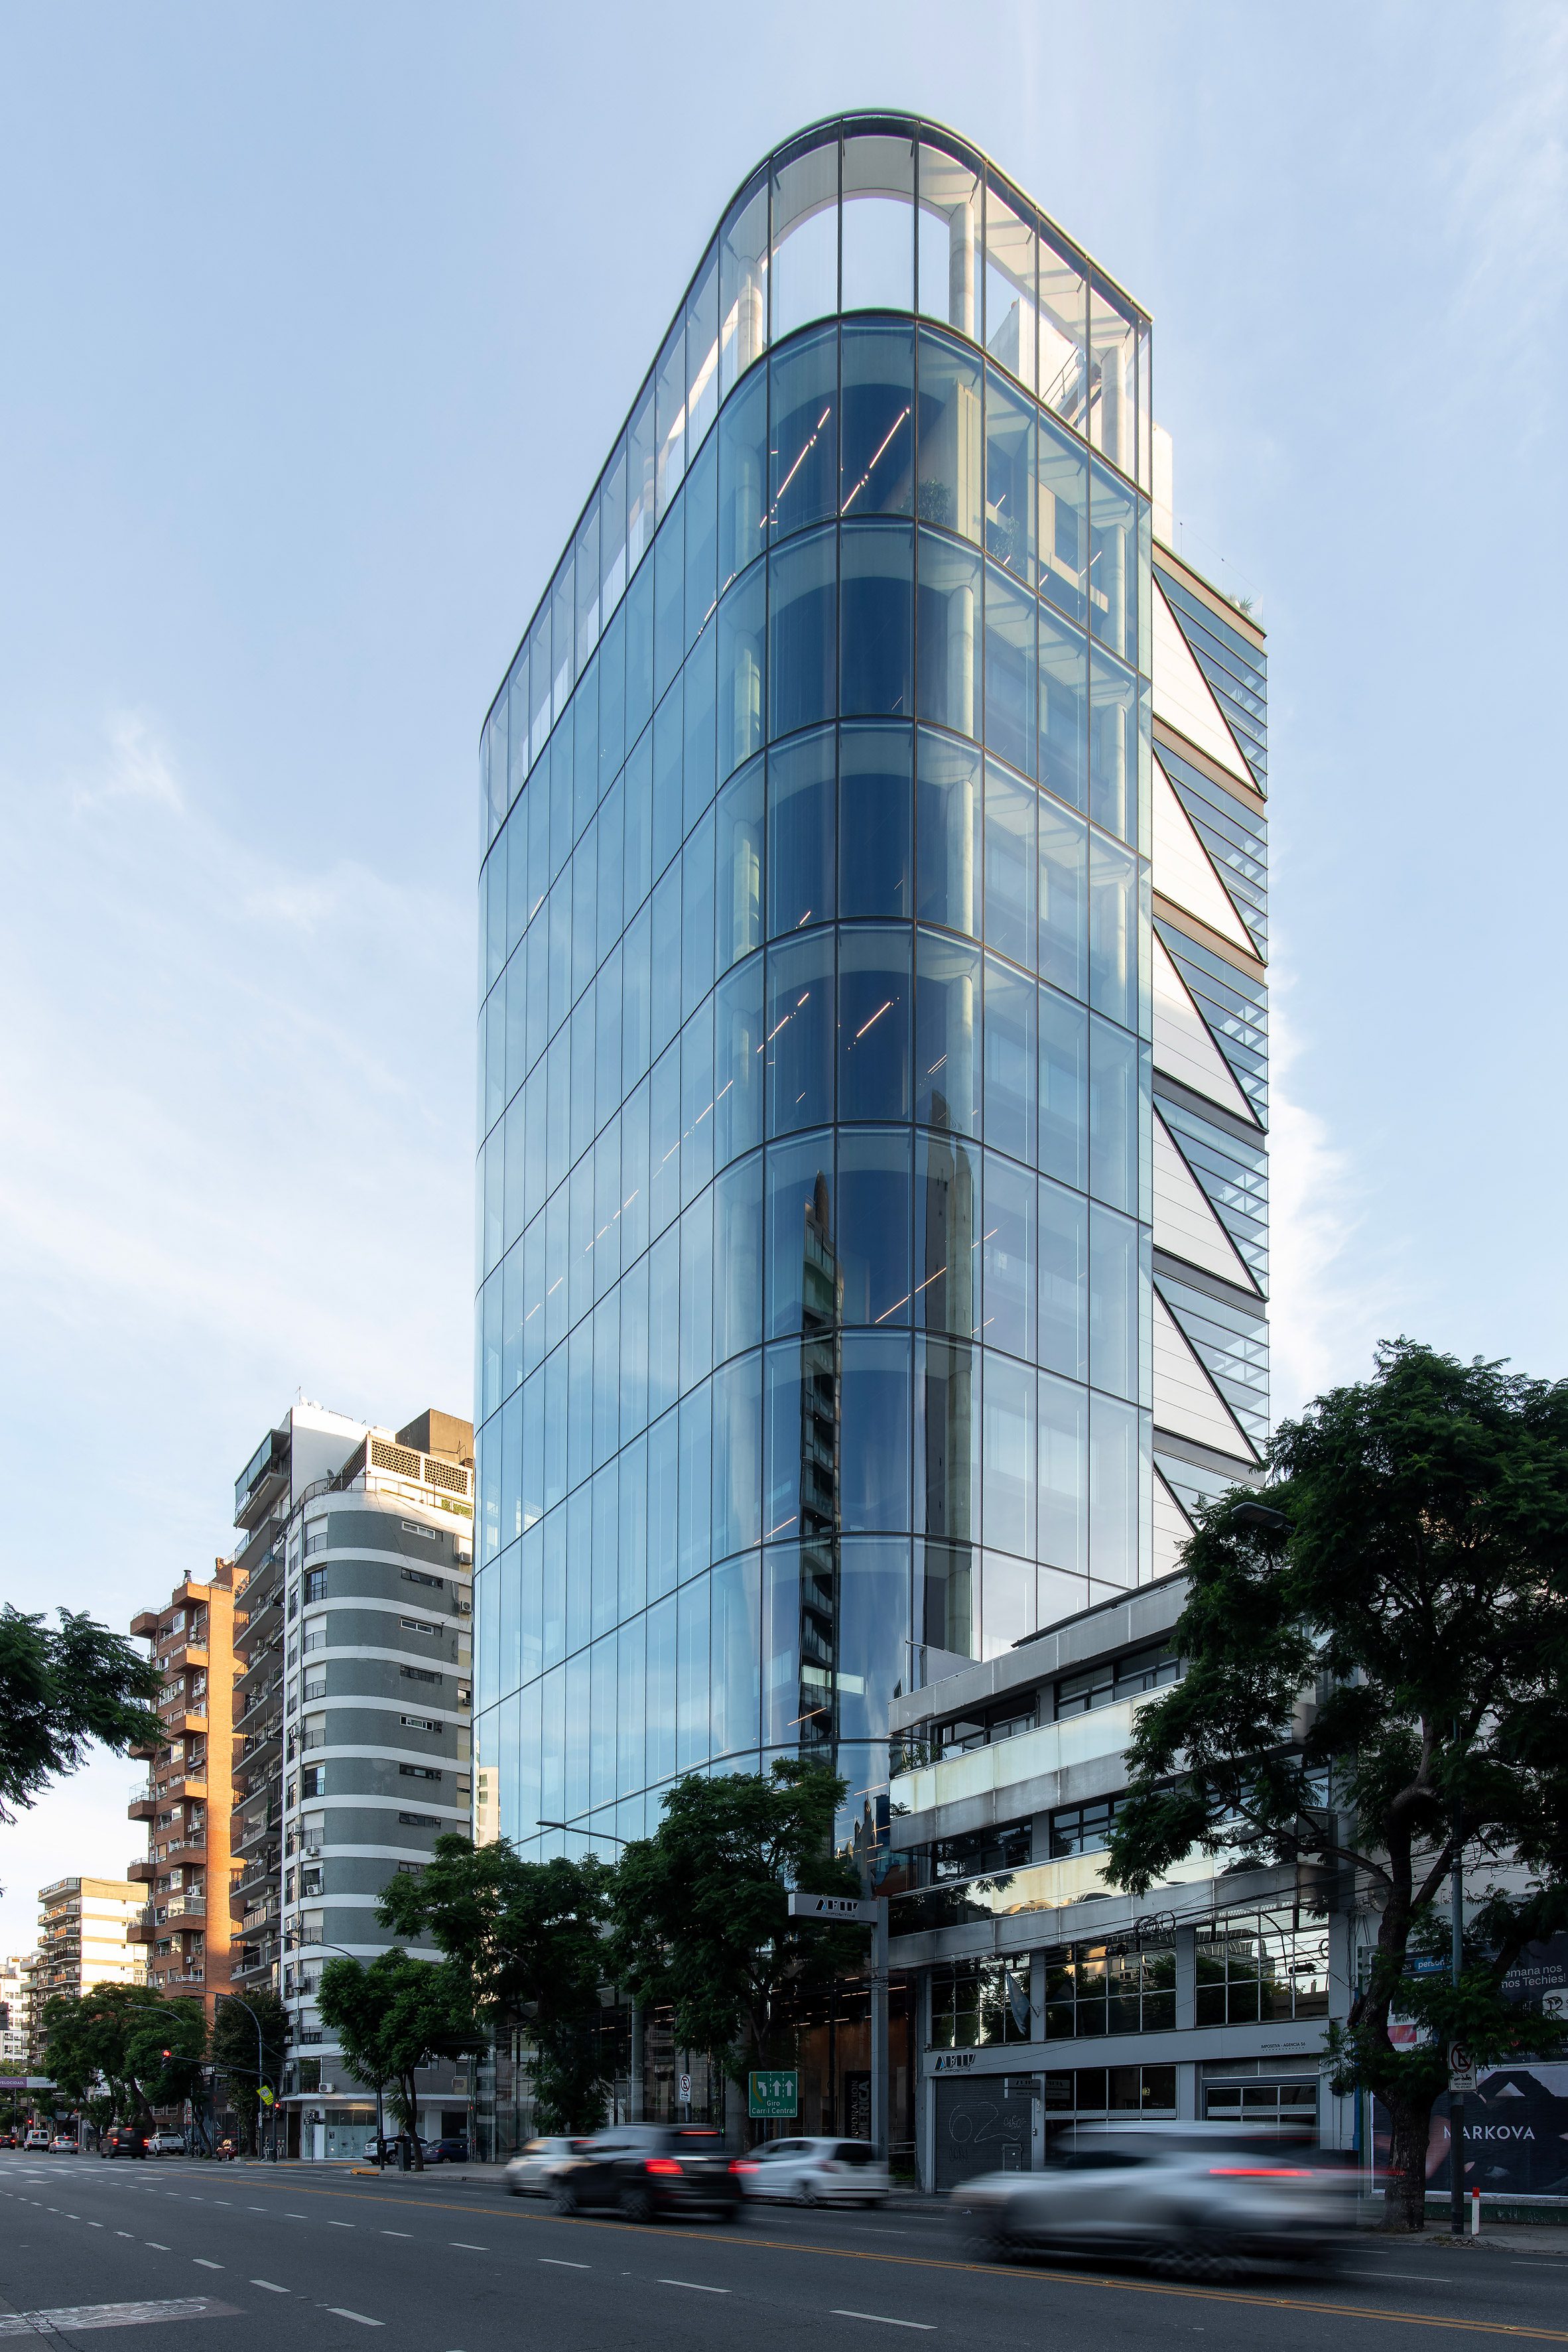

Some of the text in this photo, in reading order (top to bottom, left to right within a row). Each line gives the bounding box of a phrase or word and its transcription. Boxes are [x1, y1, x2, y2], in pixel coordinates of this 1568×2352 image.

[815, 1898, 859, 1912] AFIP
[1418, 1959, 1445, 1969] person
[1505, 1965, 1563, 1978] emana nos
[1522, 1973, 1566, 1986] Techies!
[934, 2054, 976, 2071] AFIP
[859, 2080, 870, 2140] MERICA
